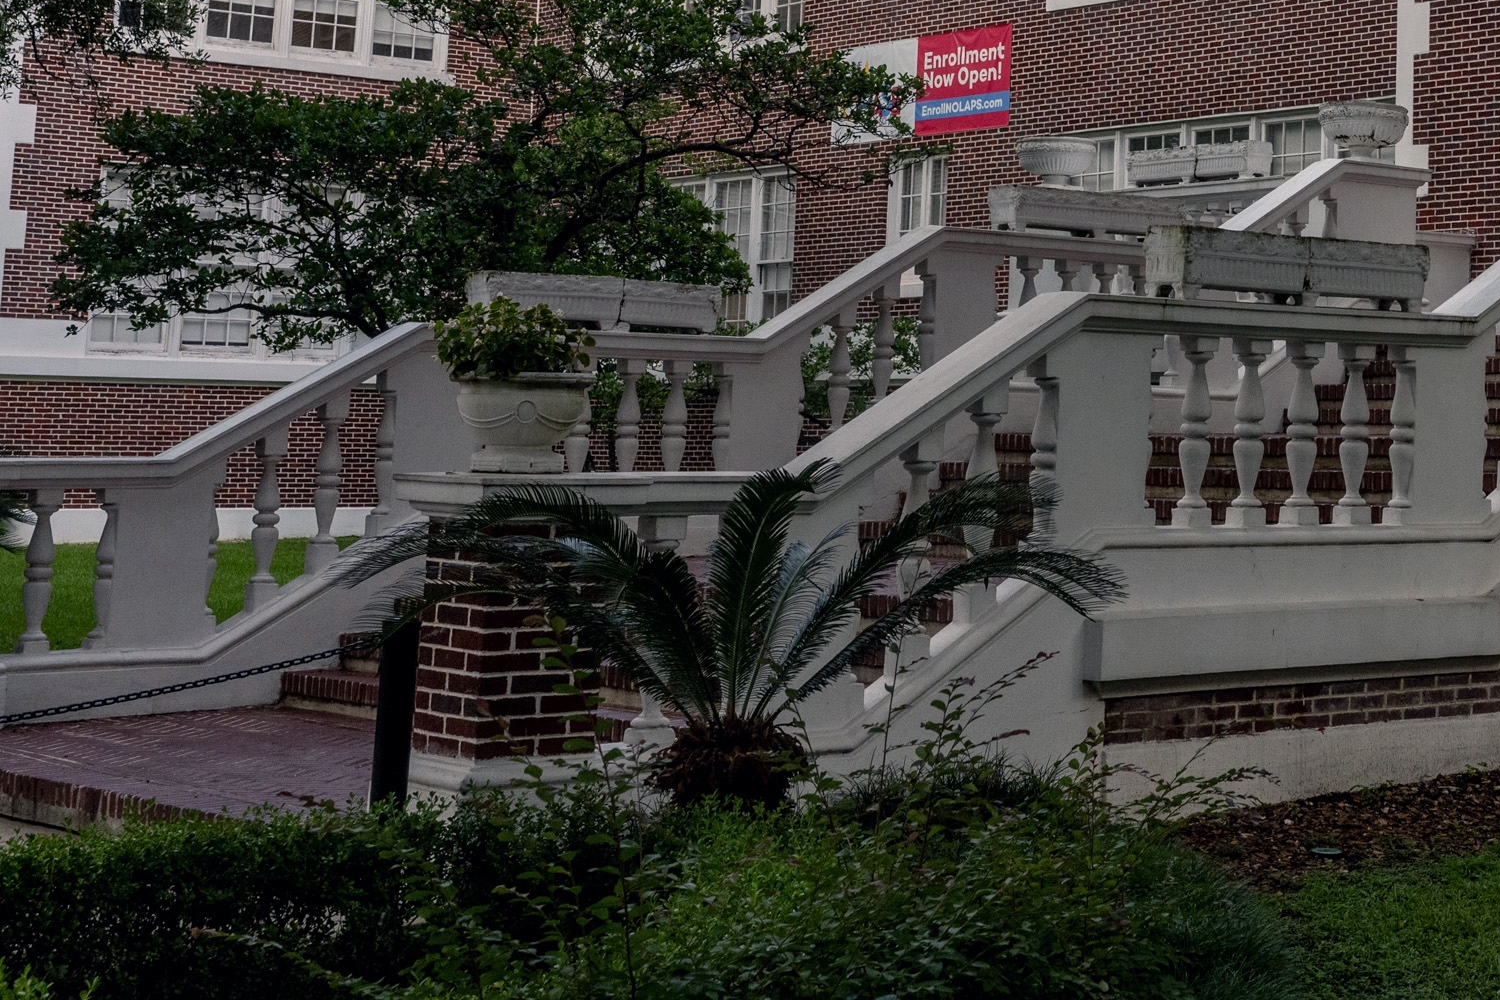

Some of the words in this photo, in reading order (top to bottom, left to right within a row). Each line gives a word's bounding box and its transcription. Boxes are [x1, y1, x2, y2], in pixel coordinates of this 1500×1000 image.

[924, 41, 1005, 70] Enrollment
[923, 71, 955, 90] Now
[958, 61, 1002, 90] Open!
[921, 98, 1003, 117] EnrollNOLAPS.com
